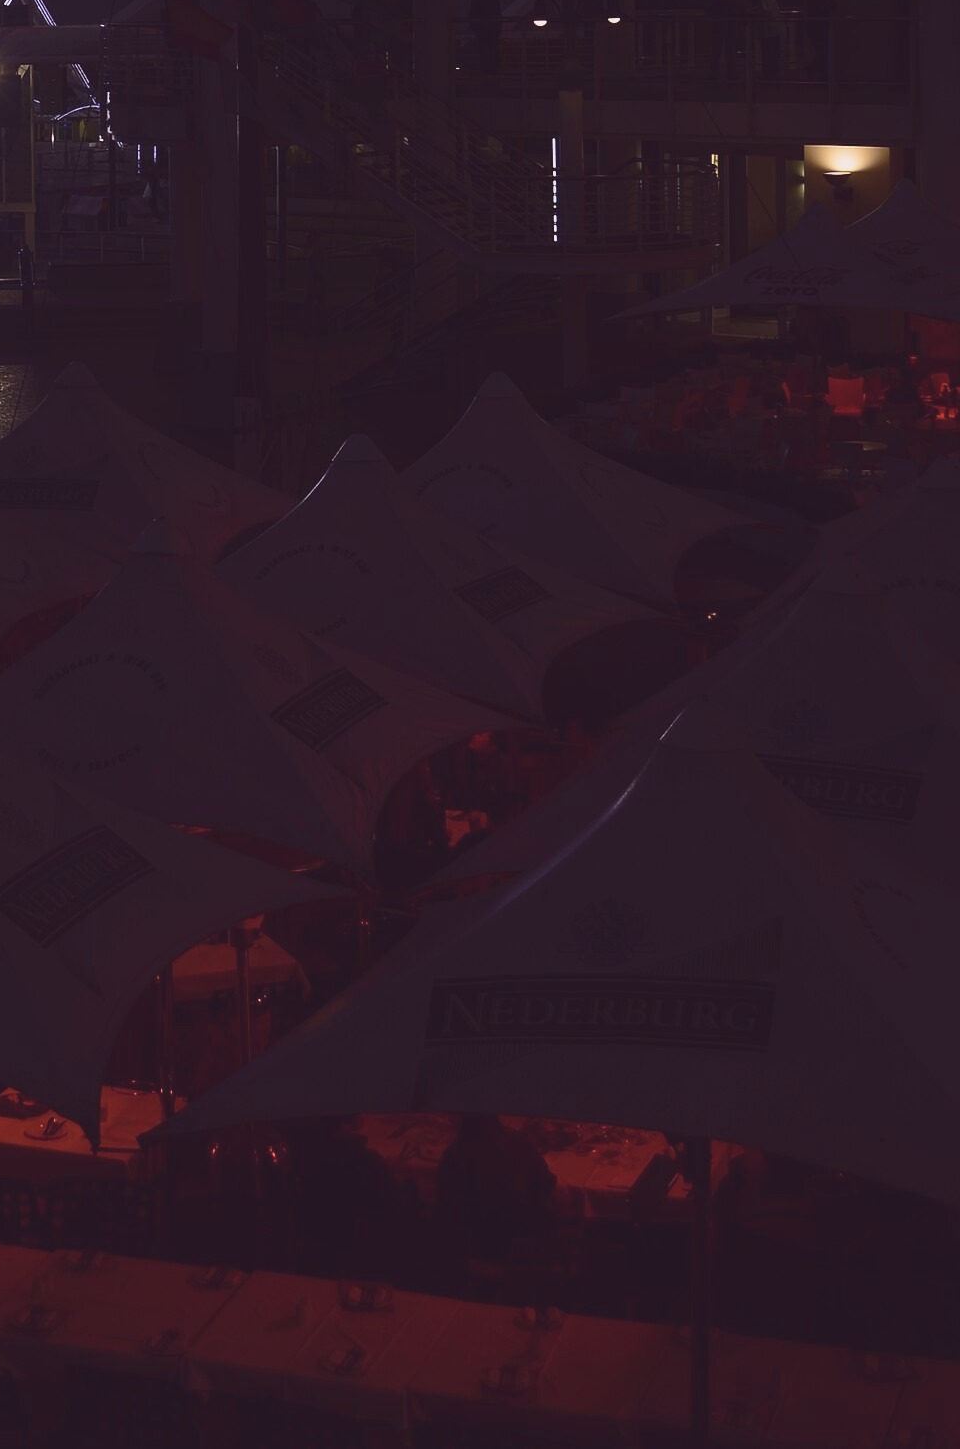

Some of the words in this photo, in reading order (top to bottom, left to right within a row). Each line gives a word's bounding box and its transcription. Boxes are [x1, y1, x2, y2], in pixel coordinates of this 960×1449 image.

[759, 285, 819, 297] zero
[5, 841, 136, 935] NEDERBURG
[441, 991, 760, 1035] NEDERBURG
